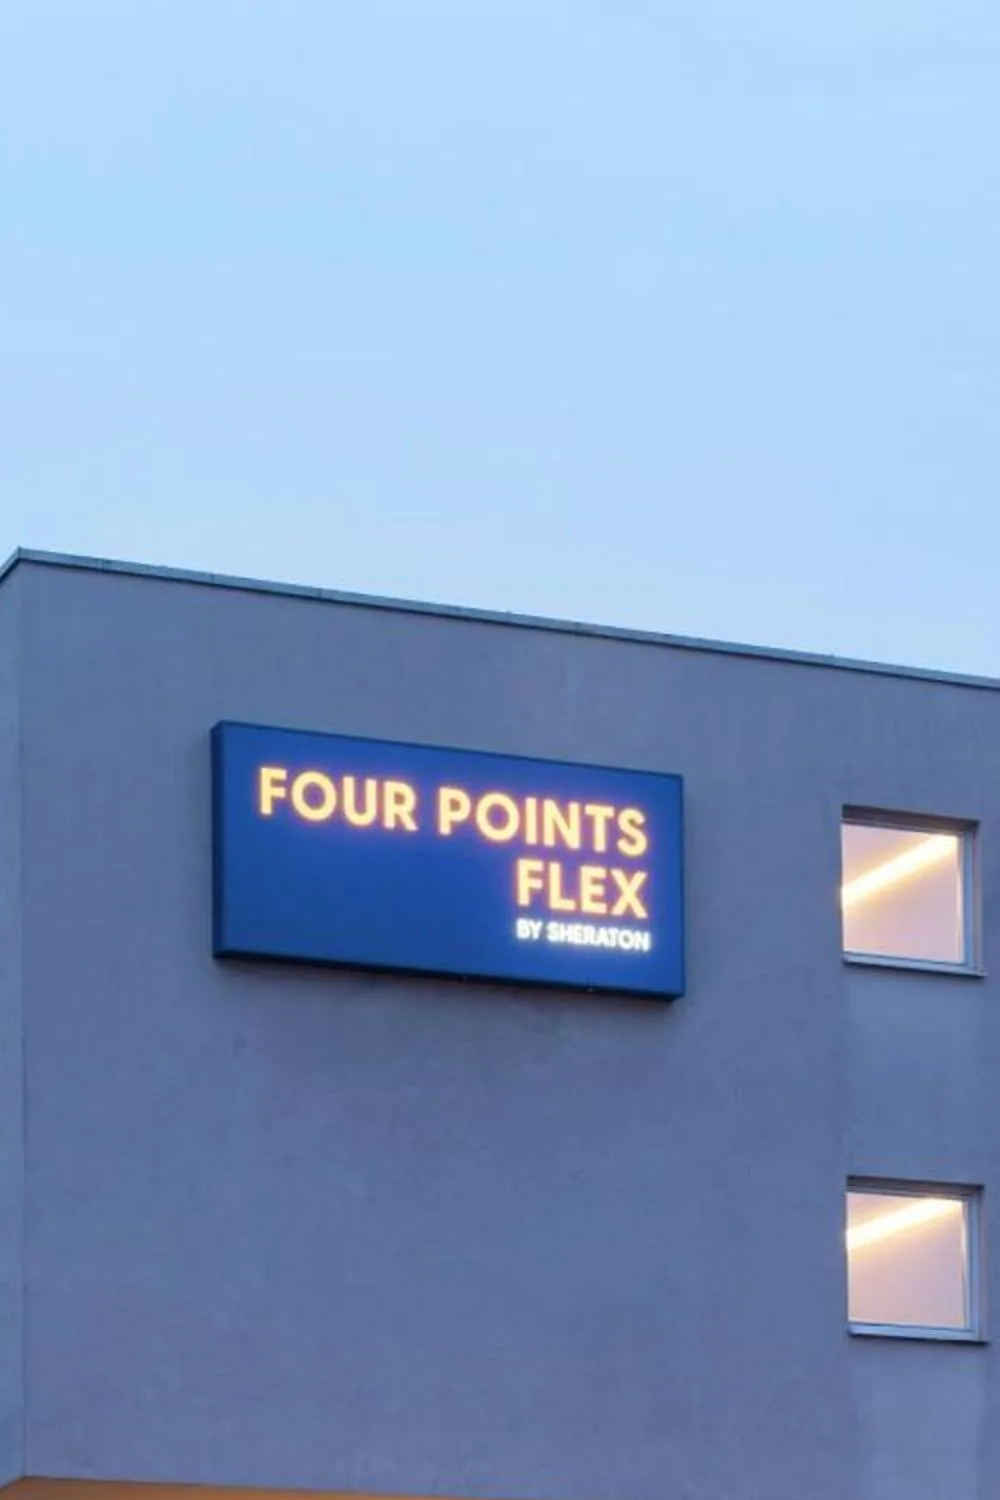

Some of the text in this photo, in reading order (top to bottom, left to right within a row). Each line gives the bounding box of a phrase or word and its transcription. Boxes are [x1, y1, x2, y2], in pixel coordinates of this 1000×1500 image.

[259, 766, 648, 857] FOUR POINTS
[515, 858, 648, 919] FLEX
[515, 917, 651, 951] BY SHERATON
